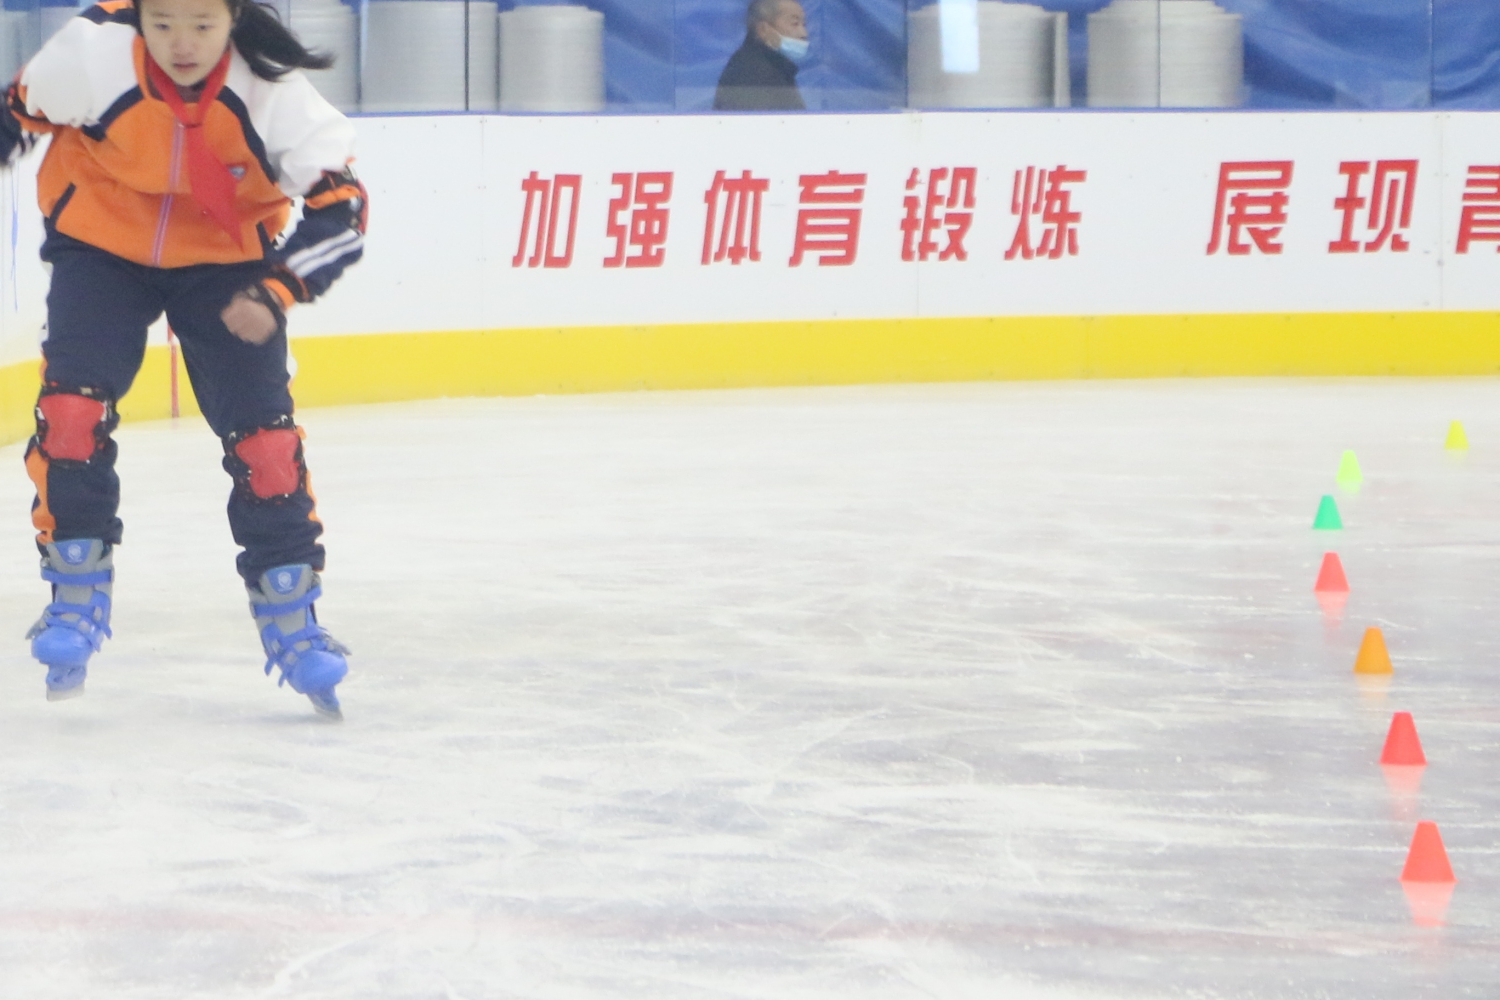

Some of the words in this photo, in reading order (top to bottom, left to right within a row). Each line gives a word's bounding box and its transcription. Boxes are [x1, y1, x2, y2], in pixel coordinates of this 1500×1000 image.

[511, 165, 1088, 269] 加强体育锻炼
